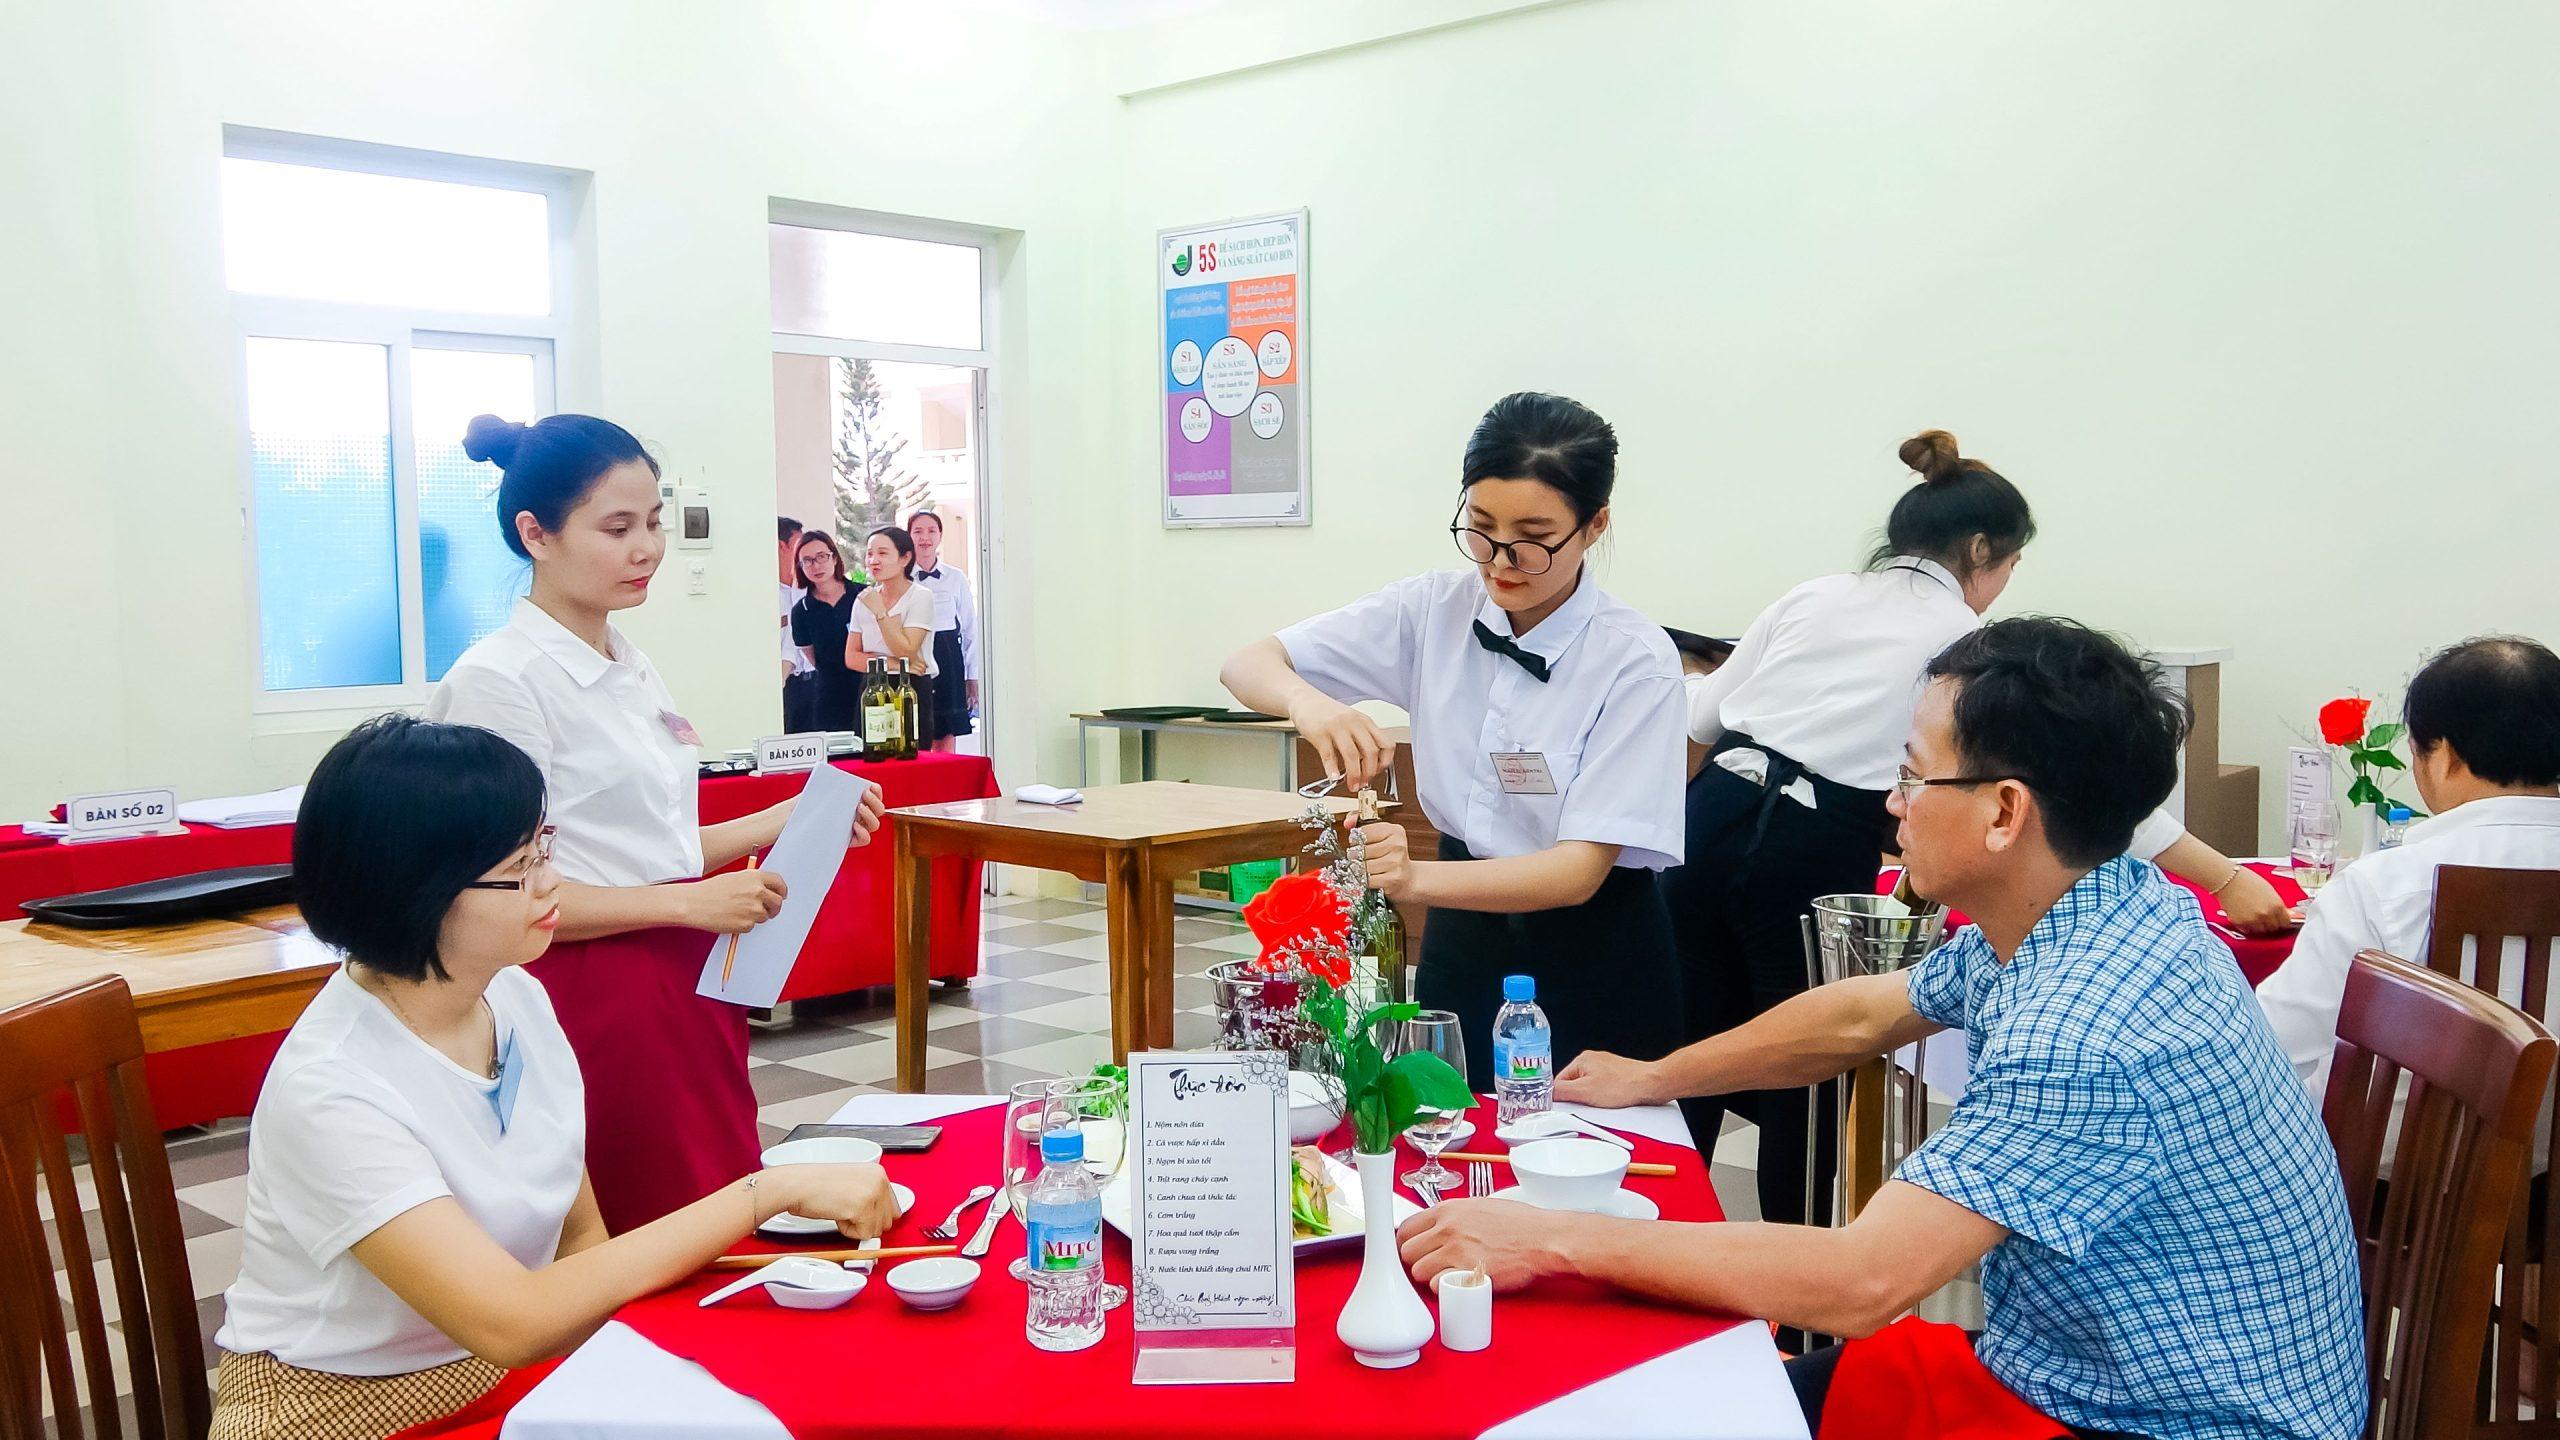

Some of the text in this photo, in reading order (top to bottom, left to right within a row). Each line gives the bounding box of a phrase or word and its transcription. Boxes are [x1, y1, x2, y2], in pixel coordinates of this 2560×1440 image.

[1199, 242, 1217, 273] 5S
[1223, 343, 1236, 356] S5
[1268, 342, 1281, 354] S2
[1181, 351, 1192, 362] S1
[1190, 407, 1202, 419] S4
[1260, 402, 1273, 415] S3
[769, 744, 816, 760] BÀN SỐ 01
[86, 801, 164, 822] BÀN SỐ 02
[1186, 1138, 1201, 1149] hấp
[1147, 1157, 1154, 1165] 3.
[1156, 1157, 1176, 1166] Ngọn
[1191, 1176, 1209, 1184] cháy
[1210, 1176, 1229, 1184] cạnh
[1197, 1193, 1206, 1201] cá
[1148, 1210, 1196, 1220] 6. Cơm trắng
[1148, 1229, 1155, 1237] 7.
[1156, 1229, 1172, 1237] Hoa
[1045, 1239, 1097, 1257] MITC
[1148, 1247, 1156, 1255] 8.
[1178, 1249, 1198, 1257] vang
[1199, 1246, 1220, 1256] trắng
[1158, 1265, 1177, 1273] Nước
[1195, 1264, 1214, 1273] khiết
[1215, 1265, 1234, 1274] đóng
[1235, 1265, 1251, 1273] chai
[1252, 1264, 1273, 1273] MITC
